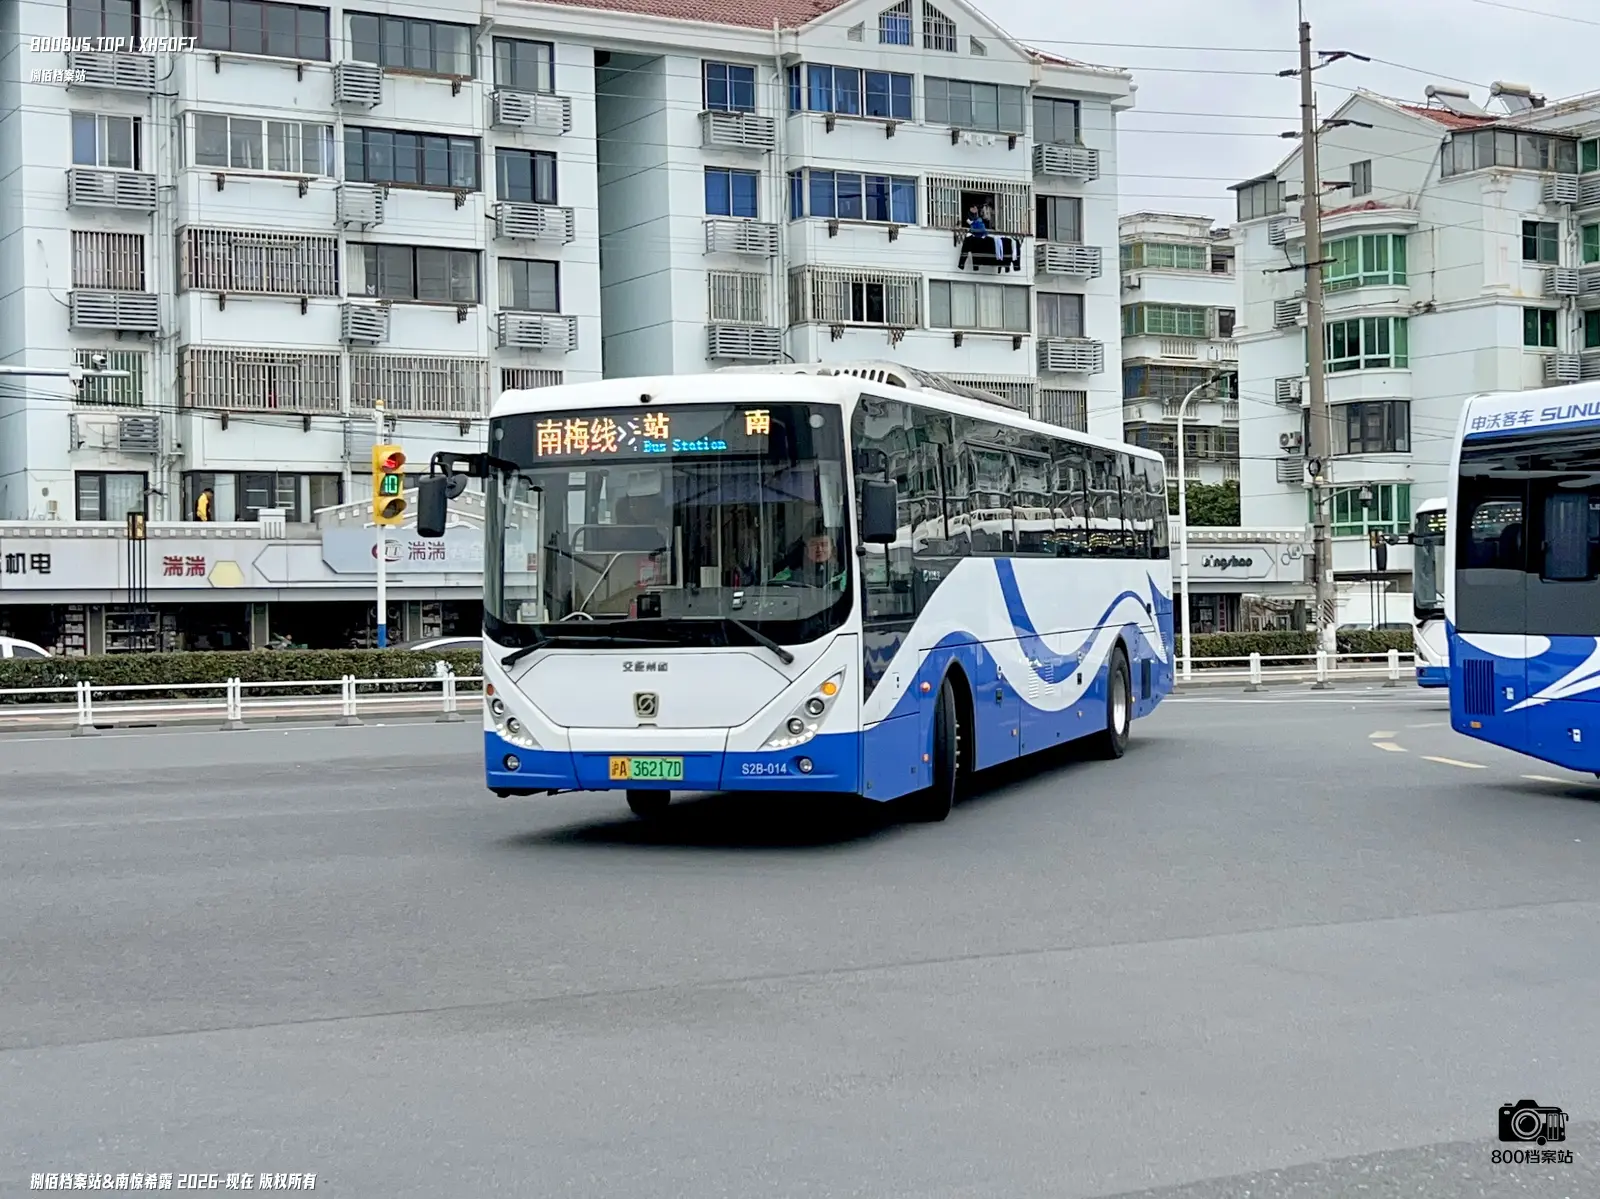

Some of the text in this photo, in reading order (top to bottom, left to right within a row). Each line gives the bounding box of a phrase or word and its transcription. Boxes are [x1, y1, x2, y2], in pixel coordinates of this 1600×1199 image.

[1471, 409, 1535, 430] 申沃客车
[537, 418, 619, 456] 南梅线
[643, 437, 727, 452] Bus Station
[0, 553, 52, 575] 机电
[741, 763, 787, 775] S2B-014
